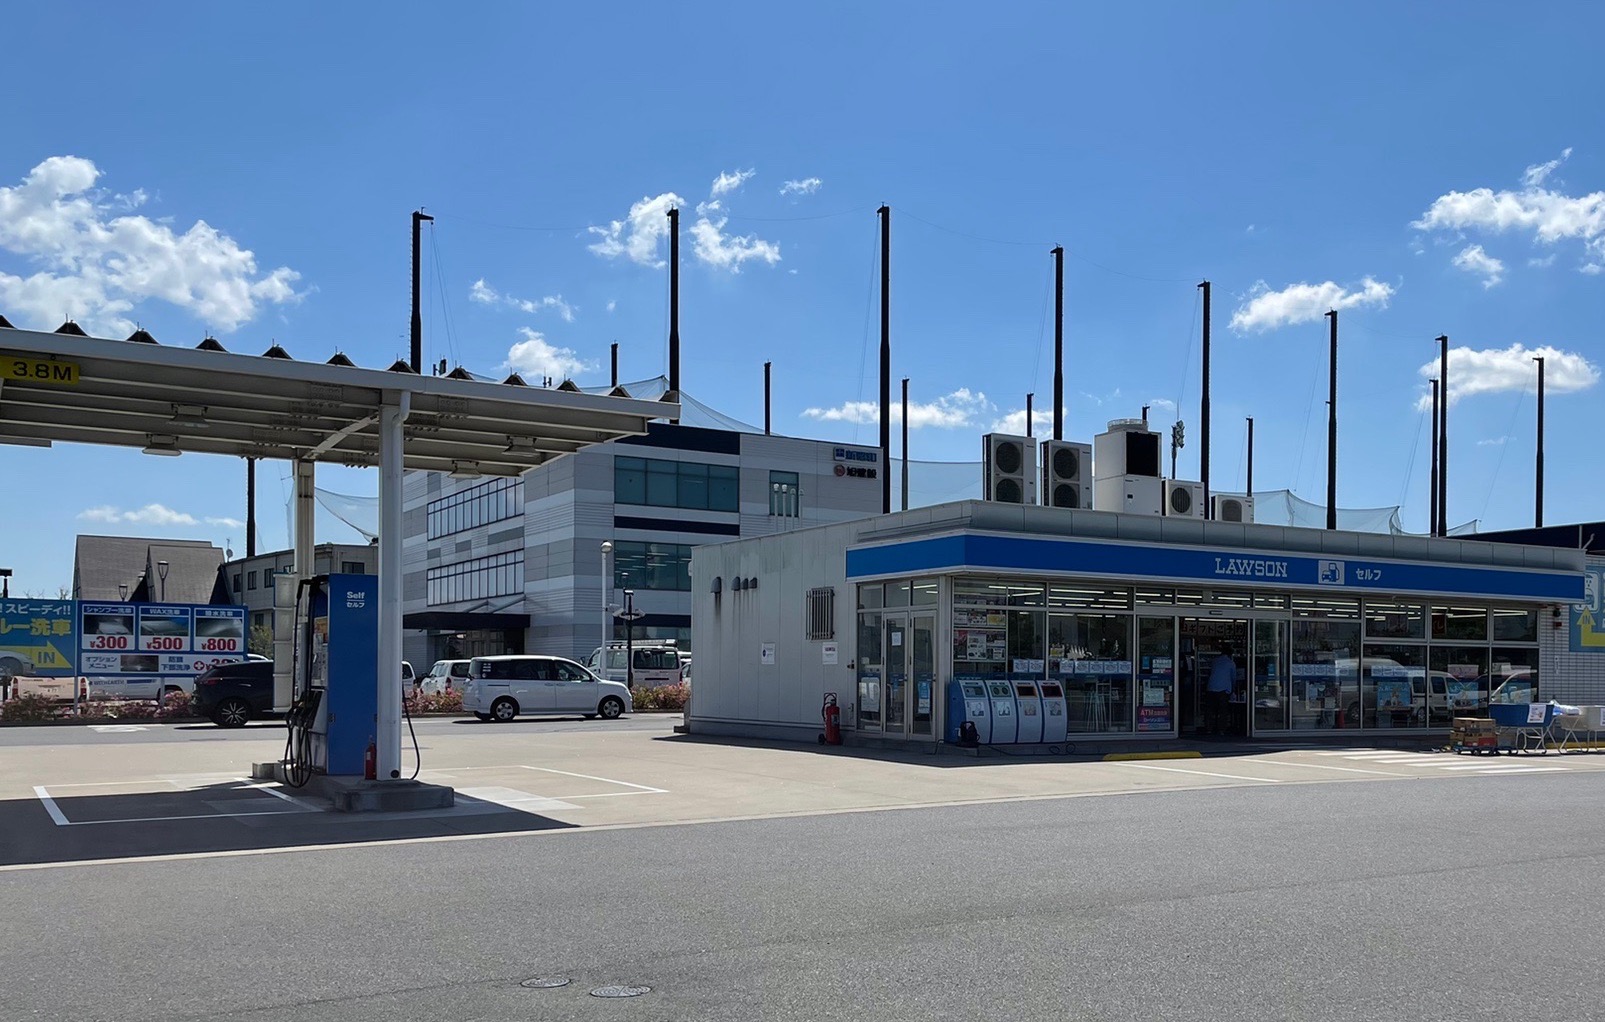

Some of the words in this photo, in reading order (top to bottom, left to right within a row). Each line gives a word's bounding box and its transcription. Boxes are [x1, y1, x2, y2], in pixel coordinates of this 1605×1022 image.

[13, 361, 72, 381] 3.8M
[1215, 558, 1288, 577] LAWSON
[1356, 568, 1382, 581] セルフ
[346, 591, 365, 599] Self
[90, 636, 127, 649] ¥300
[146, 637, 183, 650] ¥500
[201, 638, 236, 651] ¥800
[37, 651, 55, 664] IN
